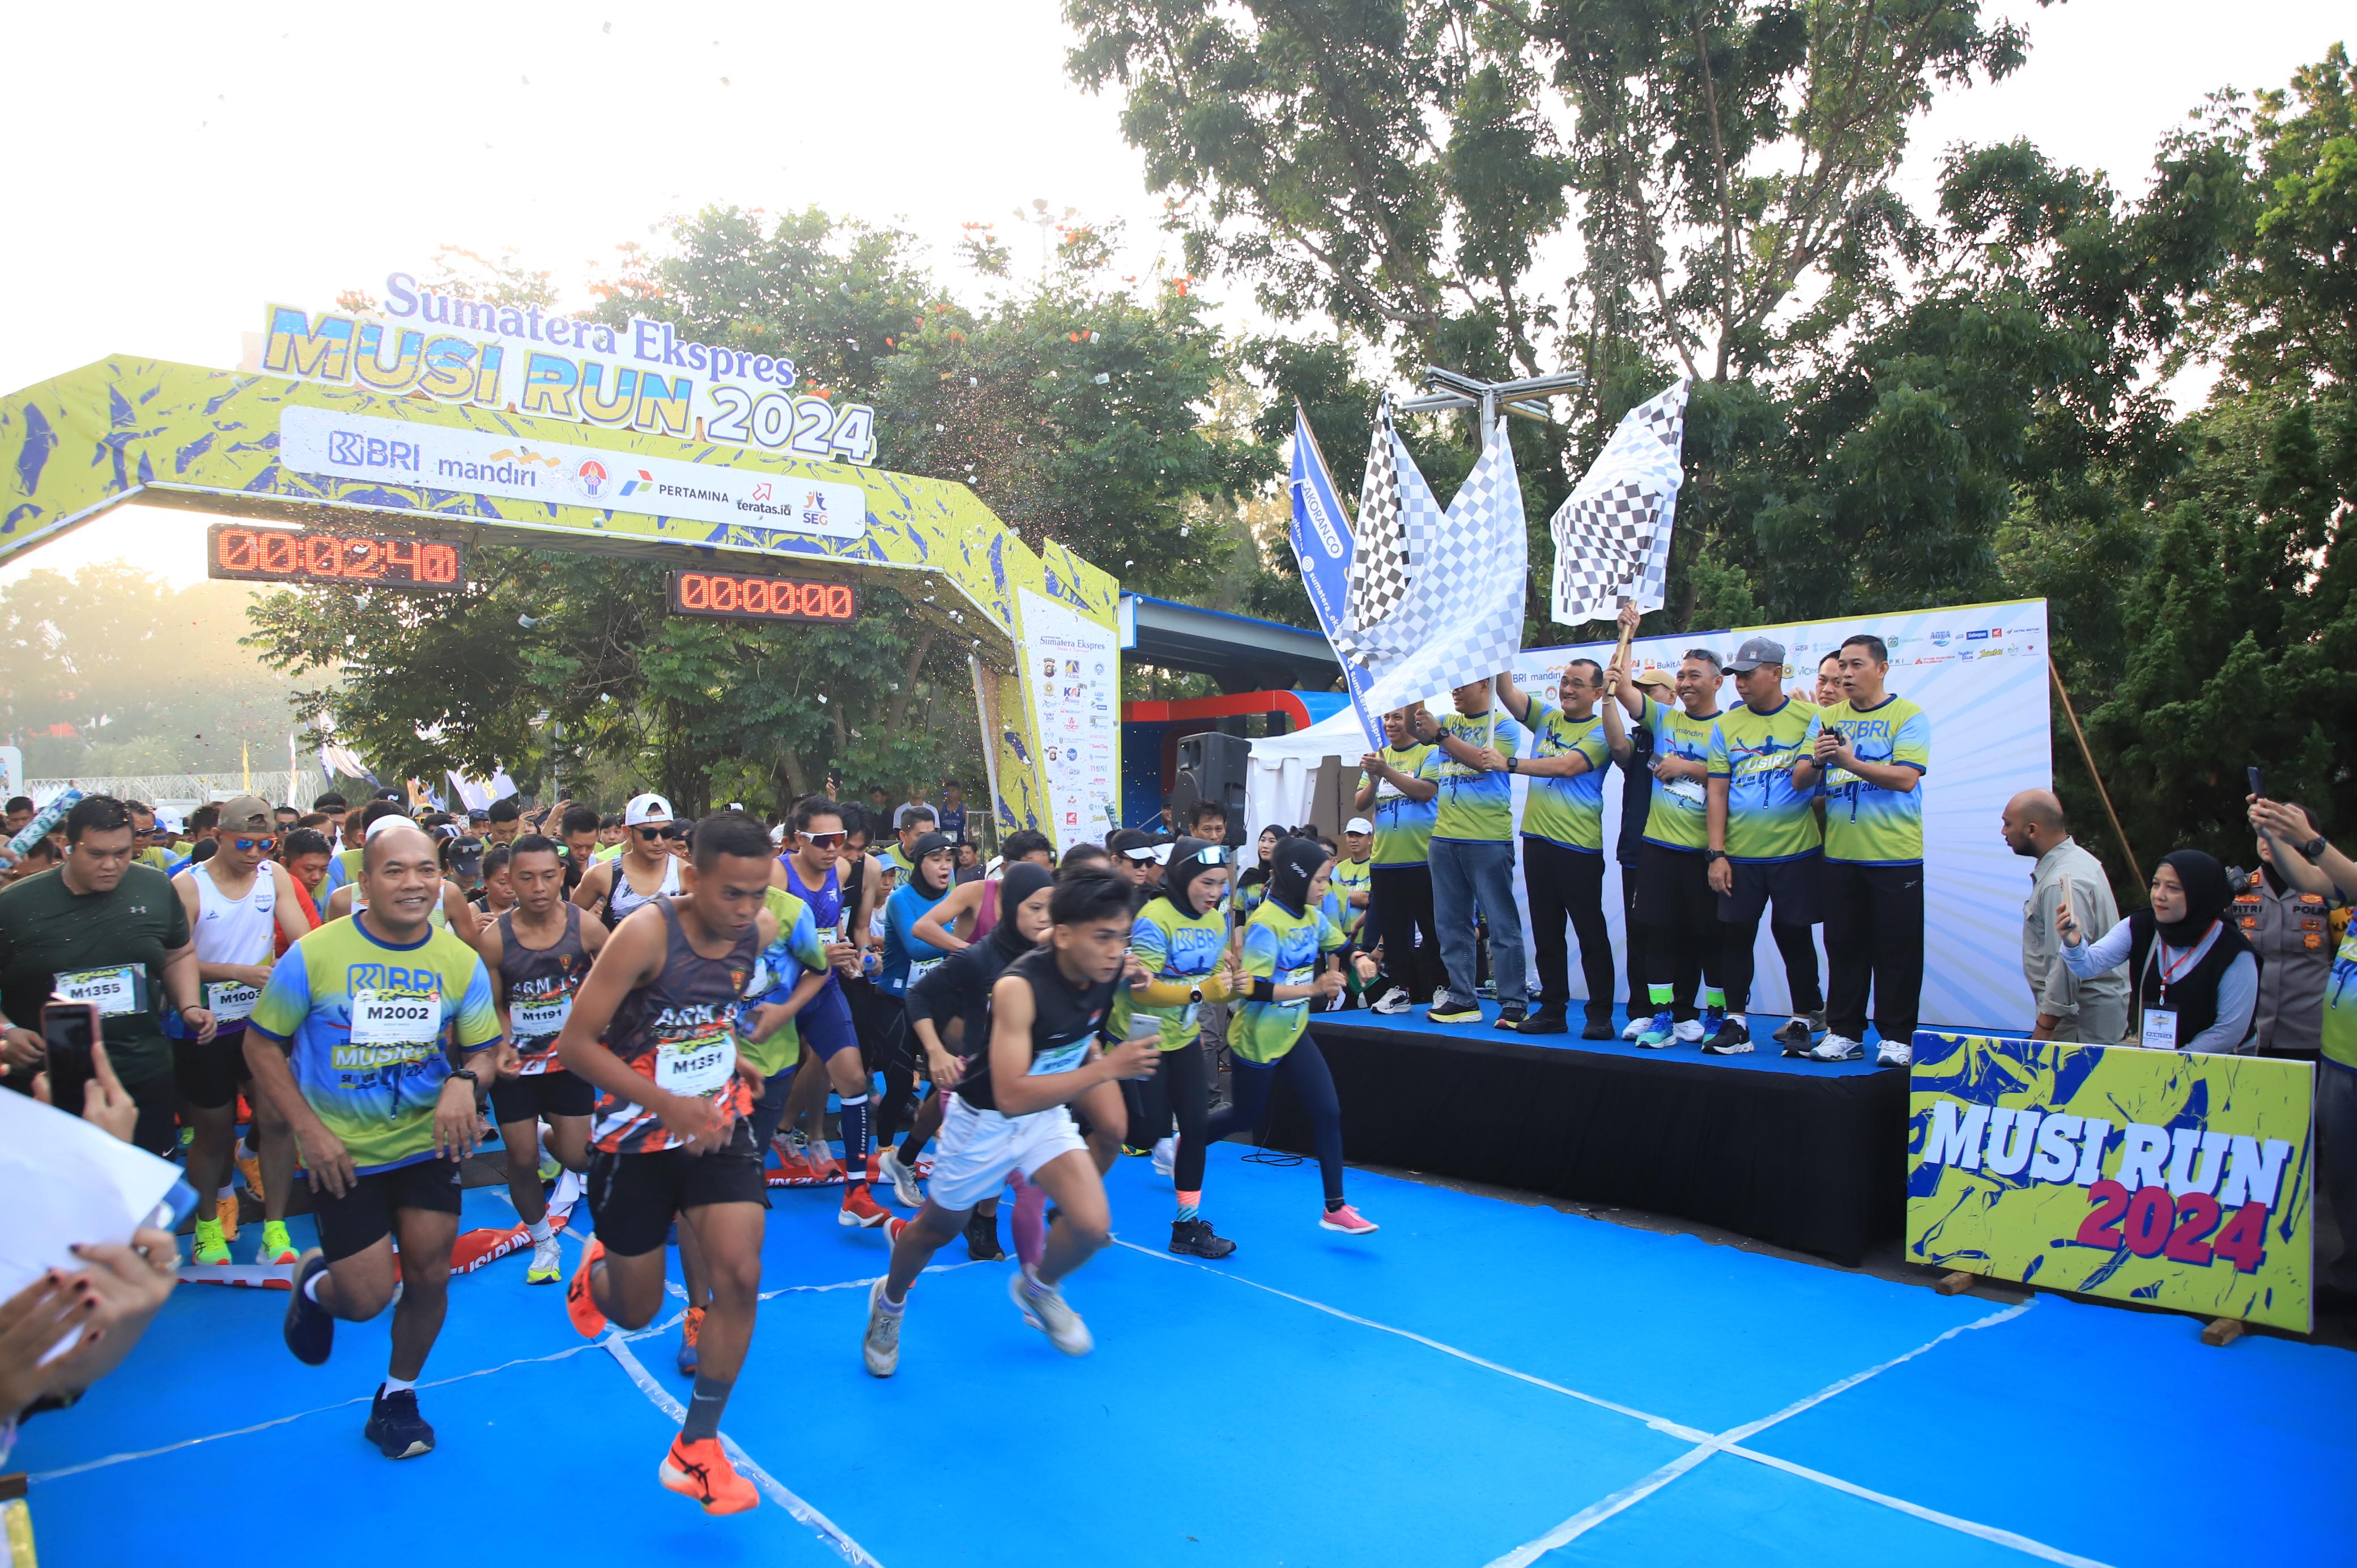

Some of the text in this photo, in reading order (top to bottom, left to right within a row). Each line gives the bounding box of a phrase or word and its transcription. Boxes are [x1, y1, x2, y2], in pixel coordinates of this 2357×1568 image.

[385, 272, 794, 385] Sumatera Ekspres
[263, 308, 872, 461] MUSI RUN 2024
[367, 438, 420, 472] BRI
[439, 459, 536, 487] mandiri
[660, 485, 729, 504] PERTAMINA
[737, 501, 791, 516] teratas.id
[803, 513, 828, 526] SEG
[219, 529, 457, 583] 00:02:40
[681, 574, 852, 618] 00:00:00
[1040, 636, 1075, 647] Sumatera
[1078, 640, 1105, 650] Ekspres
[1930, 630, 1951, 640] AQUA
[1513, 674, 1526, 683] BRI
[1531, 671, 1560, 681] mandiri
[1676, 728, 1703, 738] mandiri
[1857, 720, 1890, 739] BRI
[1774, 770, 1793, 779] 202
[1861, 783, 1879, 792] 202
[389, 966, 443, 995] BRI
[513, 977, 550, 994] ARM
[70, 983, 121, 998] M1355
[367, 1007, 429, 1019] M2002
[522, 1009, 562, 1020] M1191
[653, 1004, 717, 1026] ARM
[673, 1051, 723, 1074] M1351
[1925, 1100, 2291, 1208] MUSI RUN
[2076, 1179, 2268, 1272] 2024
